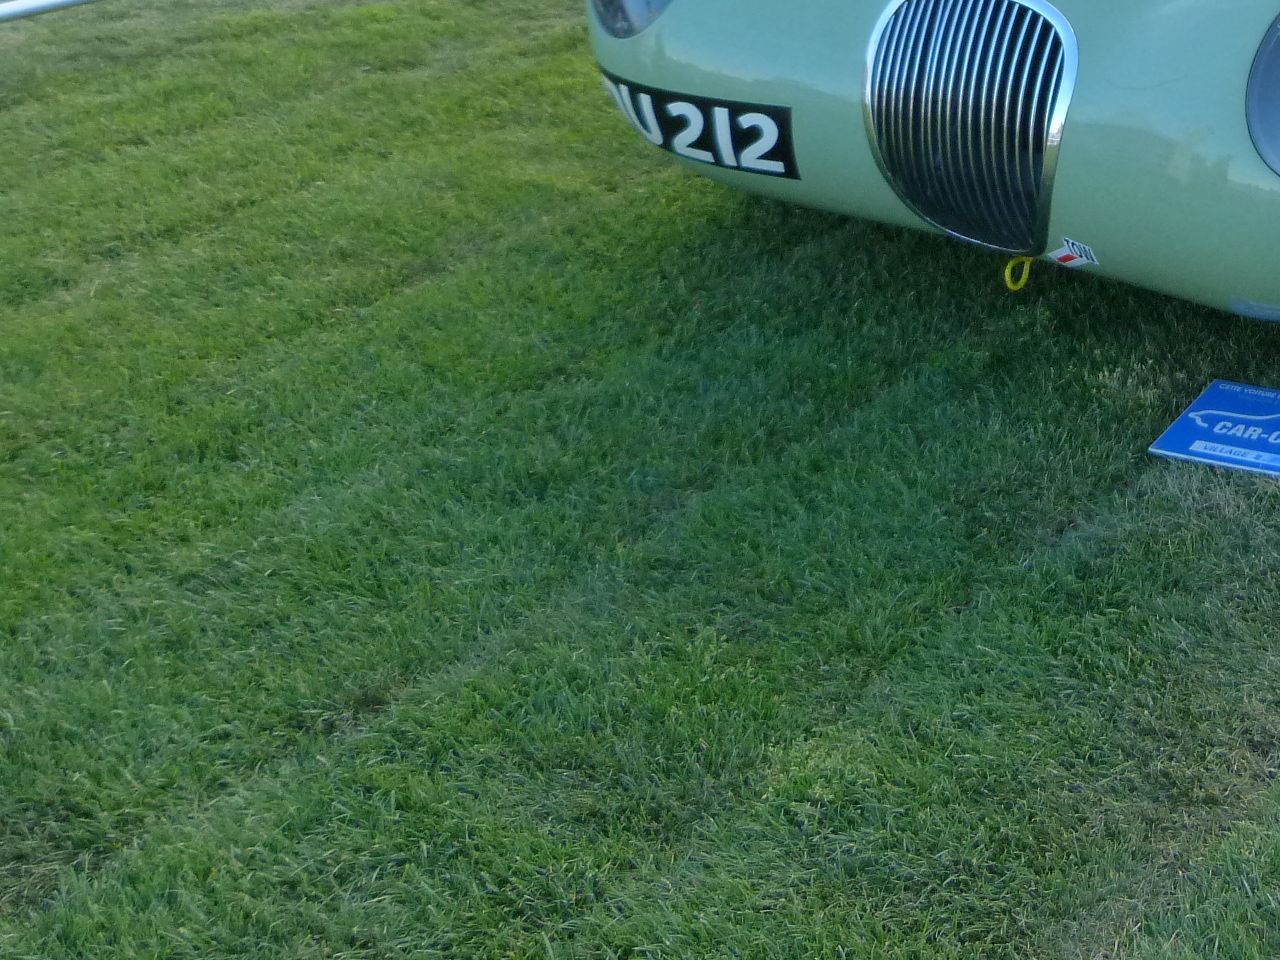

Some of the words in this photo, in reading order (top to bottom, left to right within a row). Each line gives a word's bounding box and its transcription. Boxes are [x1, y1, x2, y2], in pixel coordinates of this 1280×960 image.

[1063, 237, 1096, 263] TOW
[1218, 383, 1242, 393] CETTE
[1244, 387, 1277, 399] VOITURE
